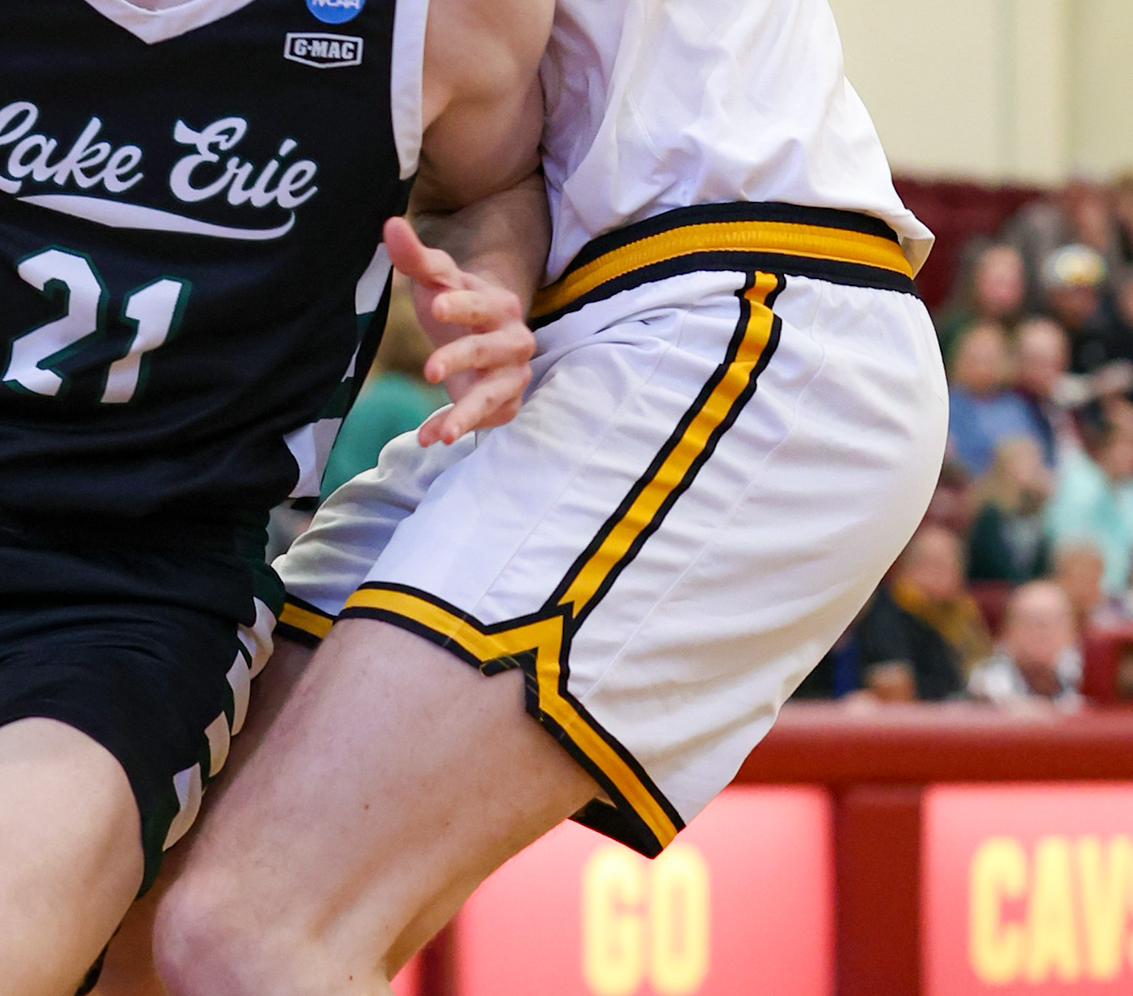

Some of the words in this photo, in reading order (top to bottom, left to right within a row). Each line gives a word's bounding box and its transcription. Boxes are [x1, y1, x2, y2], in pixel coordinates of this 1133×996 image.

[169, 116, 319, 209] Erie
[1, 244, 191, 404] 21
[582, 843, 711, 996] GO
[969, 834, 1133, 985] CAV
